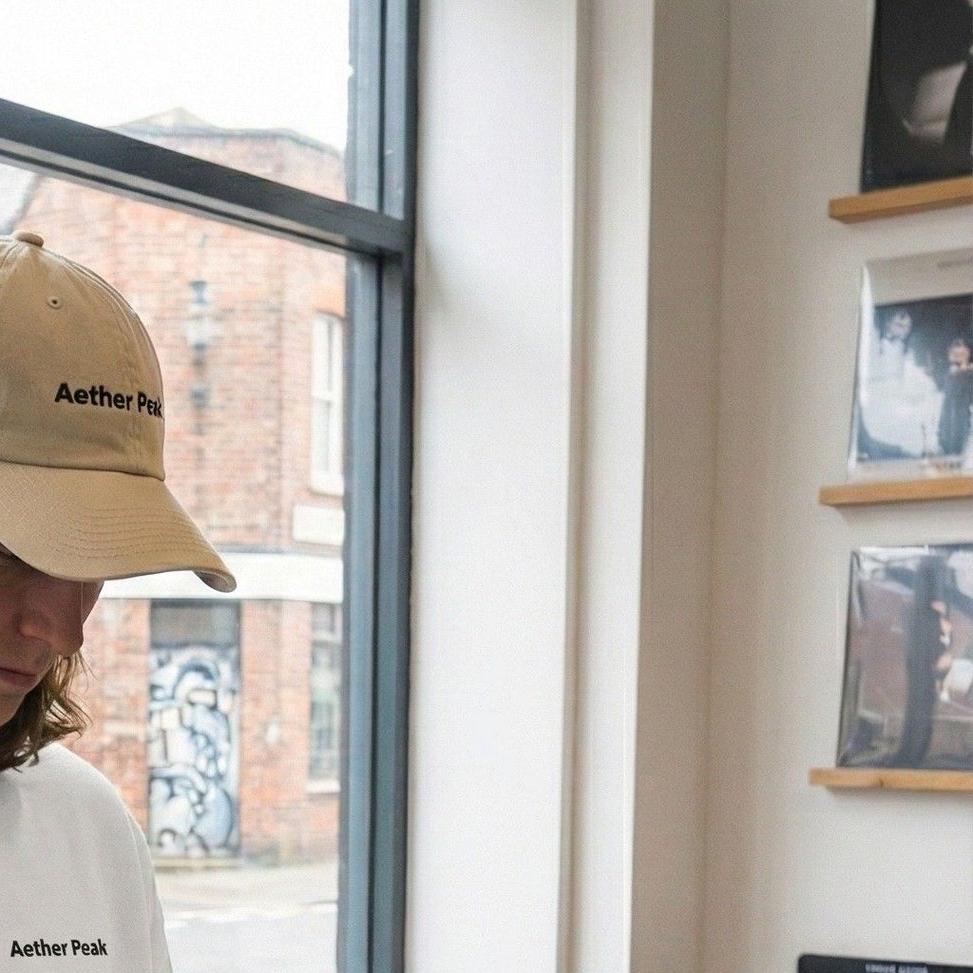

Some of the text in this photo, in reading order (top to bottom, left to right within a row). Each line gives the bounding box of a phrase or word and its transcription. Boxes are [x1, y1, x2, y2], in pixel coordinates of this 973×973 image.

[55, 383, 133, 411] Aether
[10, 939, 108, 957] Aether Peak
